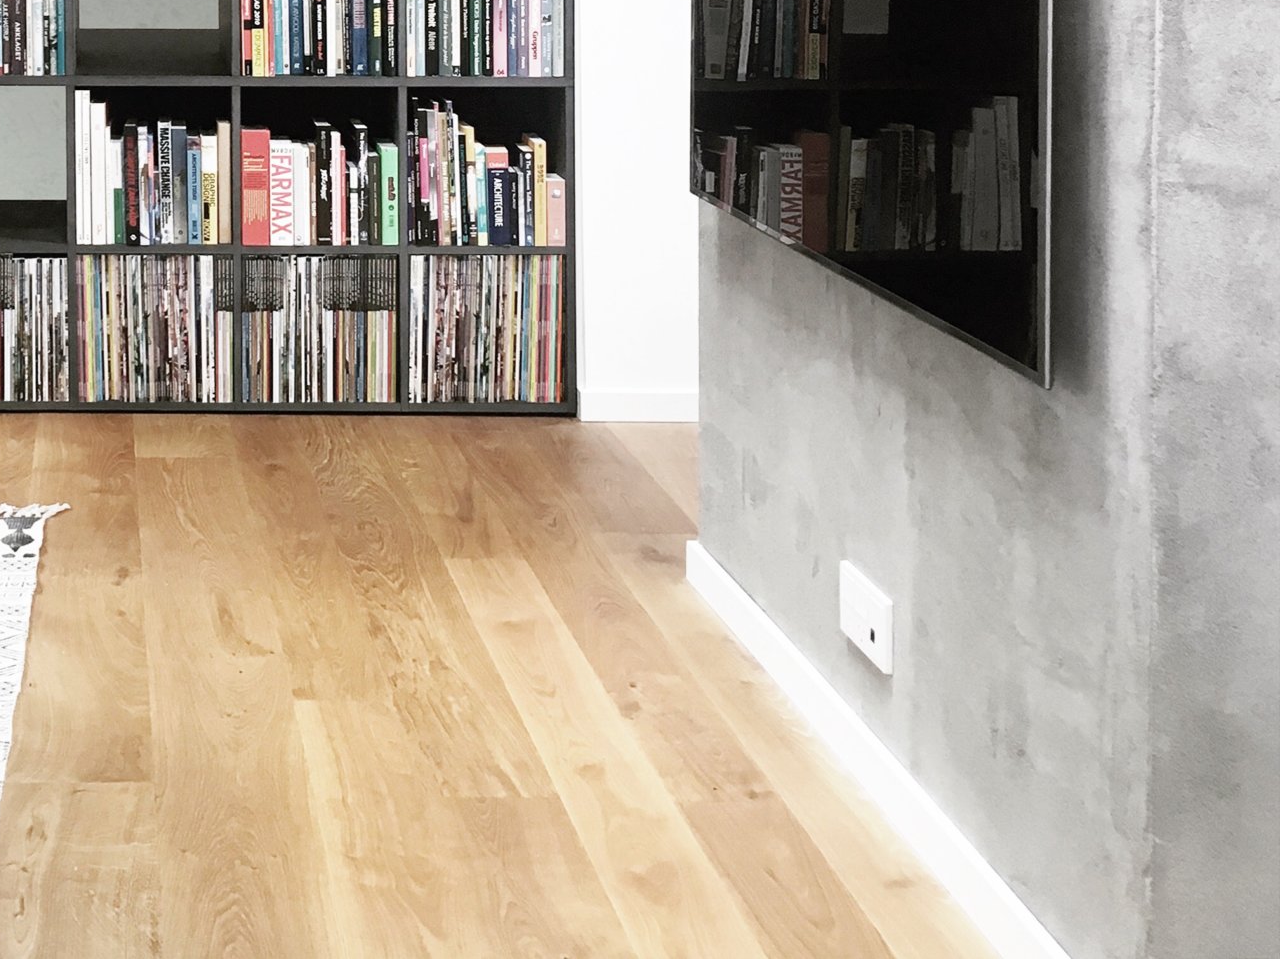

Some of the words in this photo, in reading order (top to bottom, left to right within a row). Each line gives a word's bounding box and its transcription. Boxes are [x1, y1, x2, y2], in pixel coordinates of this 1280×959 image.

[428, 3, 436, 27] Treholt
[428, 31, 436, 50] Alene
[159, 128, 170, 165] MASSIVE
[127, 151, 135, 185] COMPLETE
[160, 166, 171, 199] CHANGE
[128, 187, 136, 205] ZAHA
[271, 155, 292, 235] FARMAX
[494, 178, 503, 227] ARCHITECTURE
[129, 206, 137, 226] HADID
